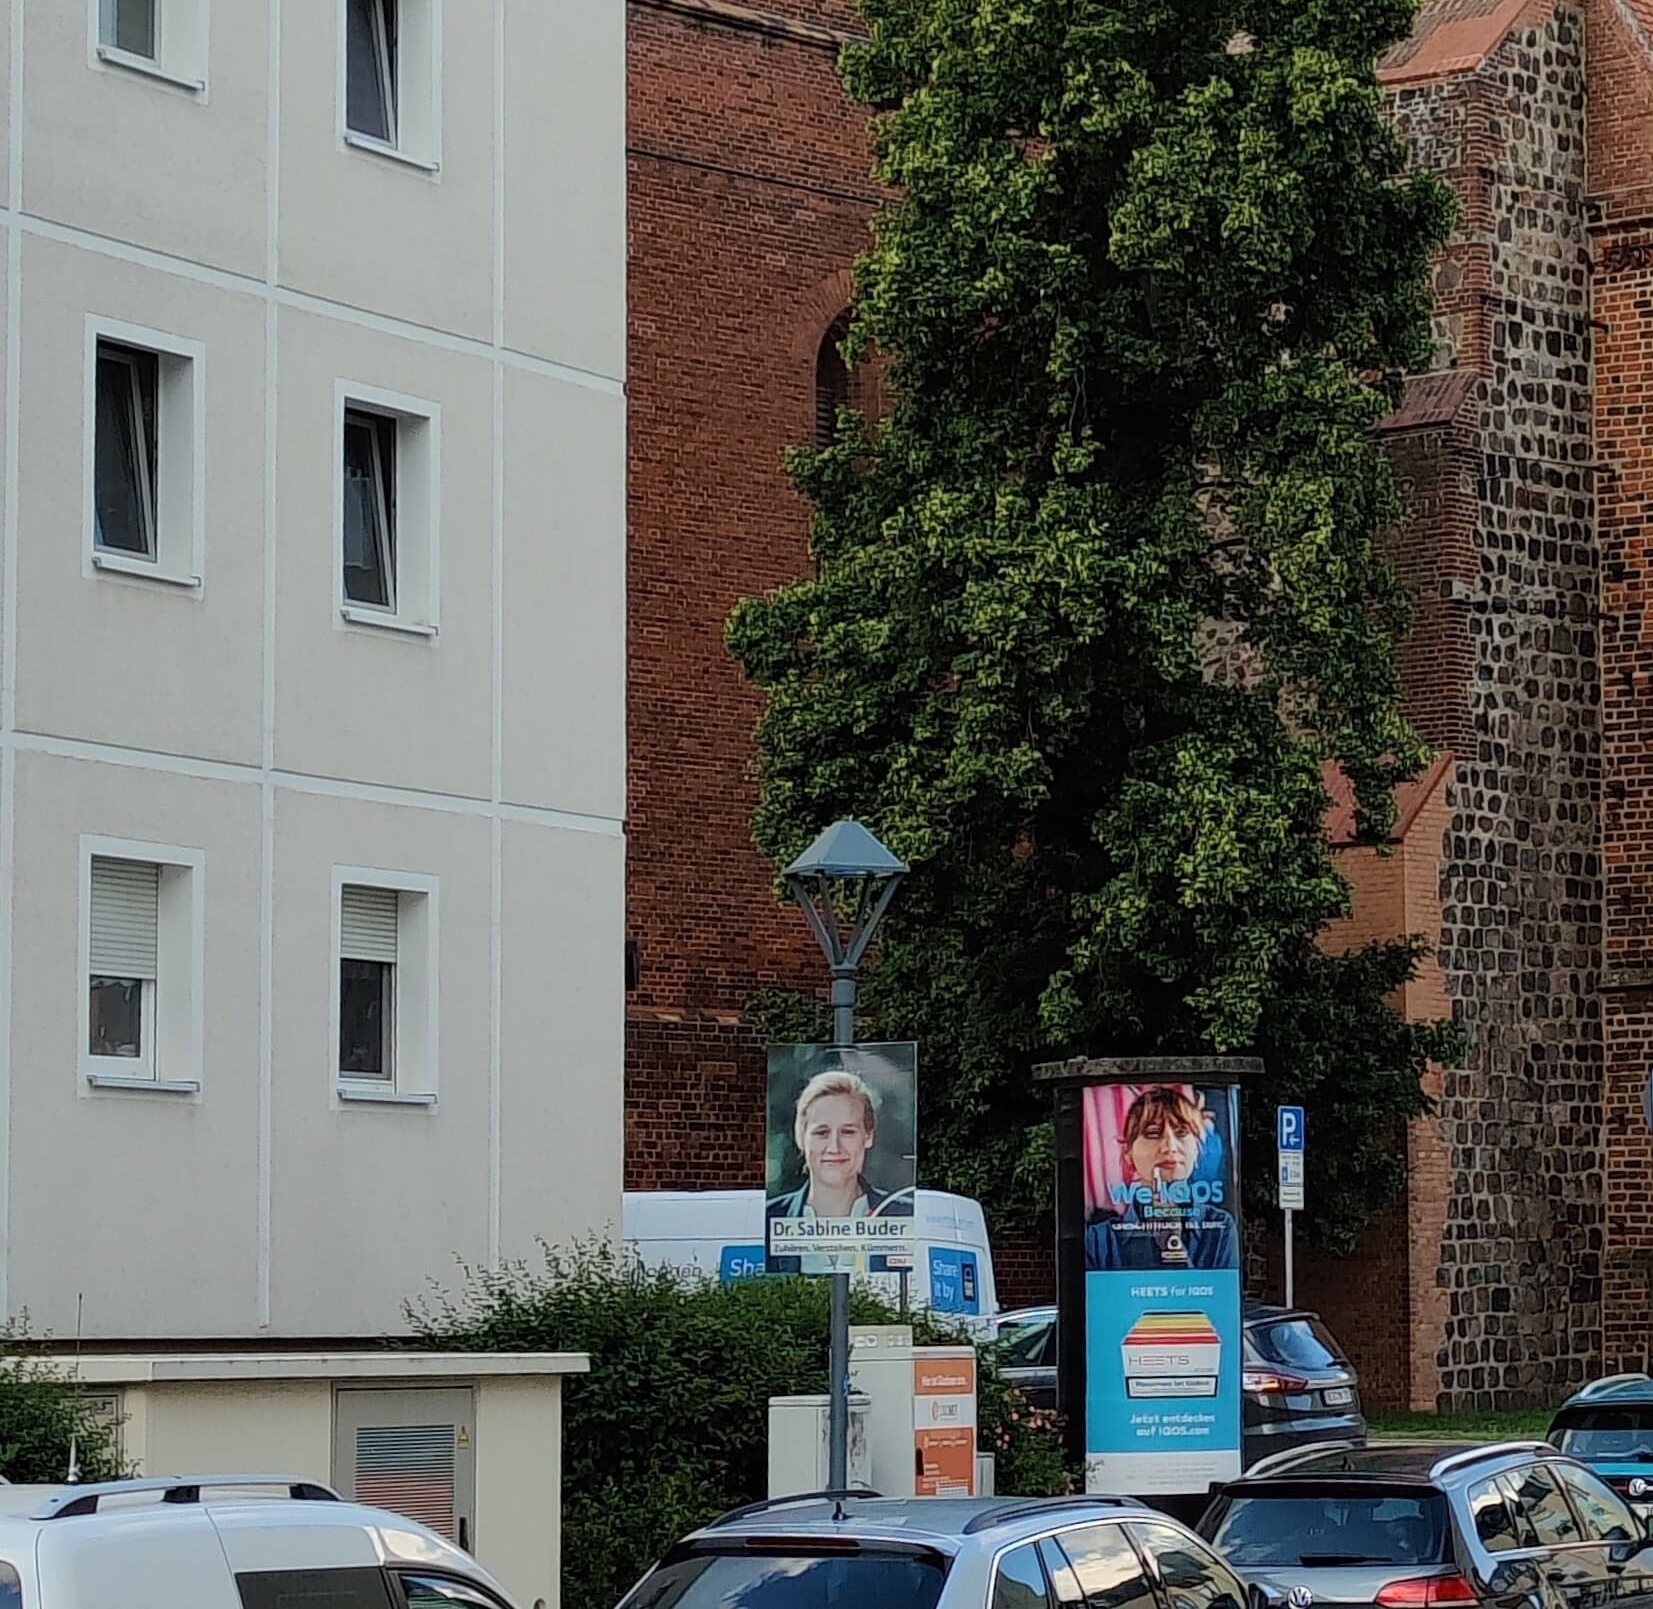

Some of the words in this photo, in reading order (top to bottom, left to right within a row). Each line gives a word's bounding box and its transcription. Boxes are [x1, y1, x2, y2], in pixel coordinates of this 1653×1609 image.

[1282, 1112, 1297, 1146] P
[1107, 1182, 1152, 1205] We
[1159, 1180, 1224, 1204] IQOS
[1143, 1206, 1200, 1218] Because
[774, 1221, 794, 1236] Dr.
[797, 1220, 851, 1236] Sabine
[855, 1220, 907, 1236] Buder
[729, 1258, 765, 1278] Sha
[1131, 1286, 1168, 1297] HEETS
[1170, 1286, 1186, 1296] for
[1188, 1285, 1214, 1296] IQOS
[1128, 1355, 1190, 1366] HEETS
